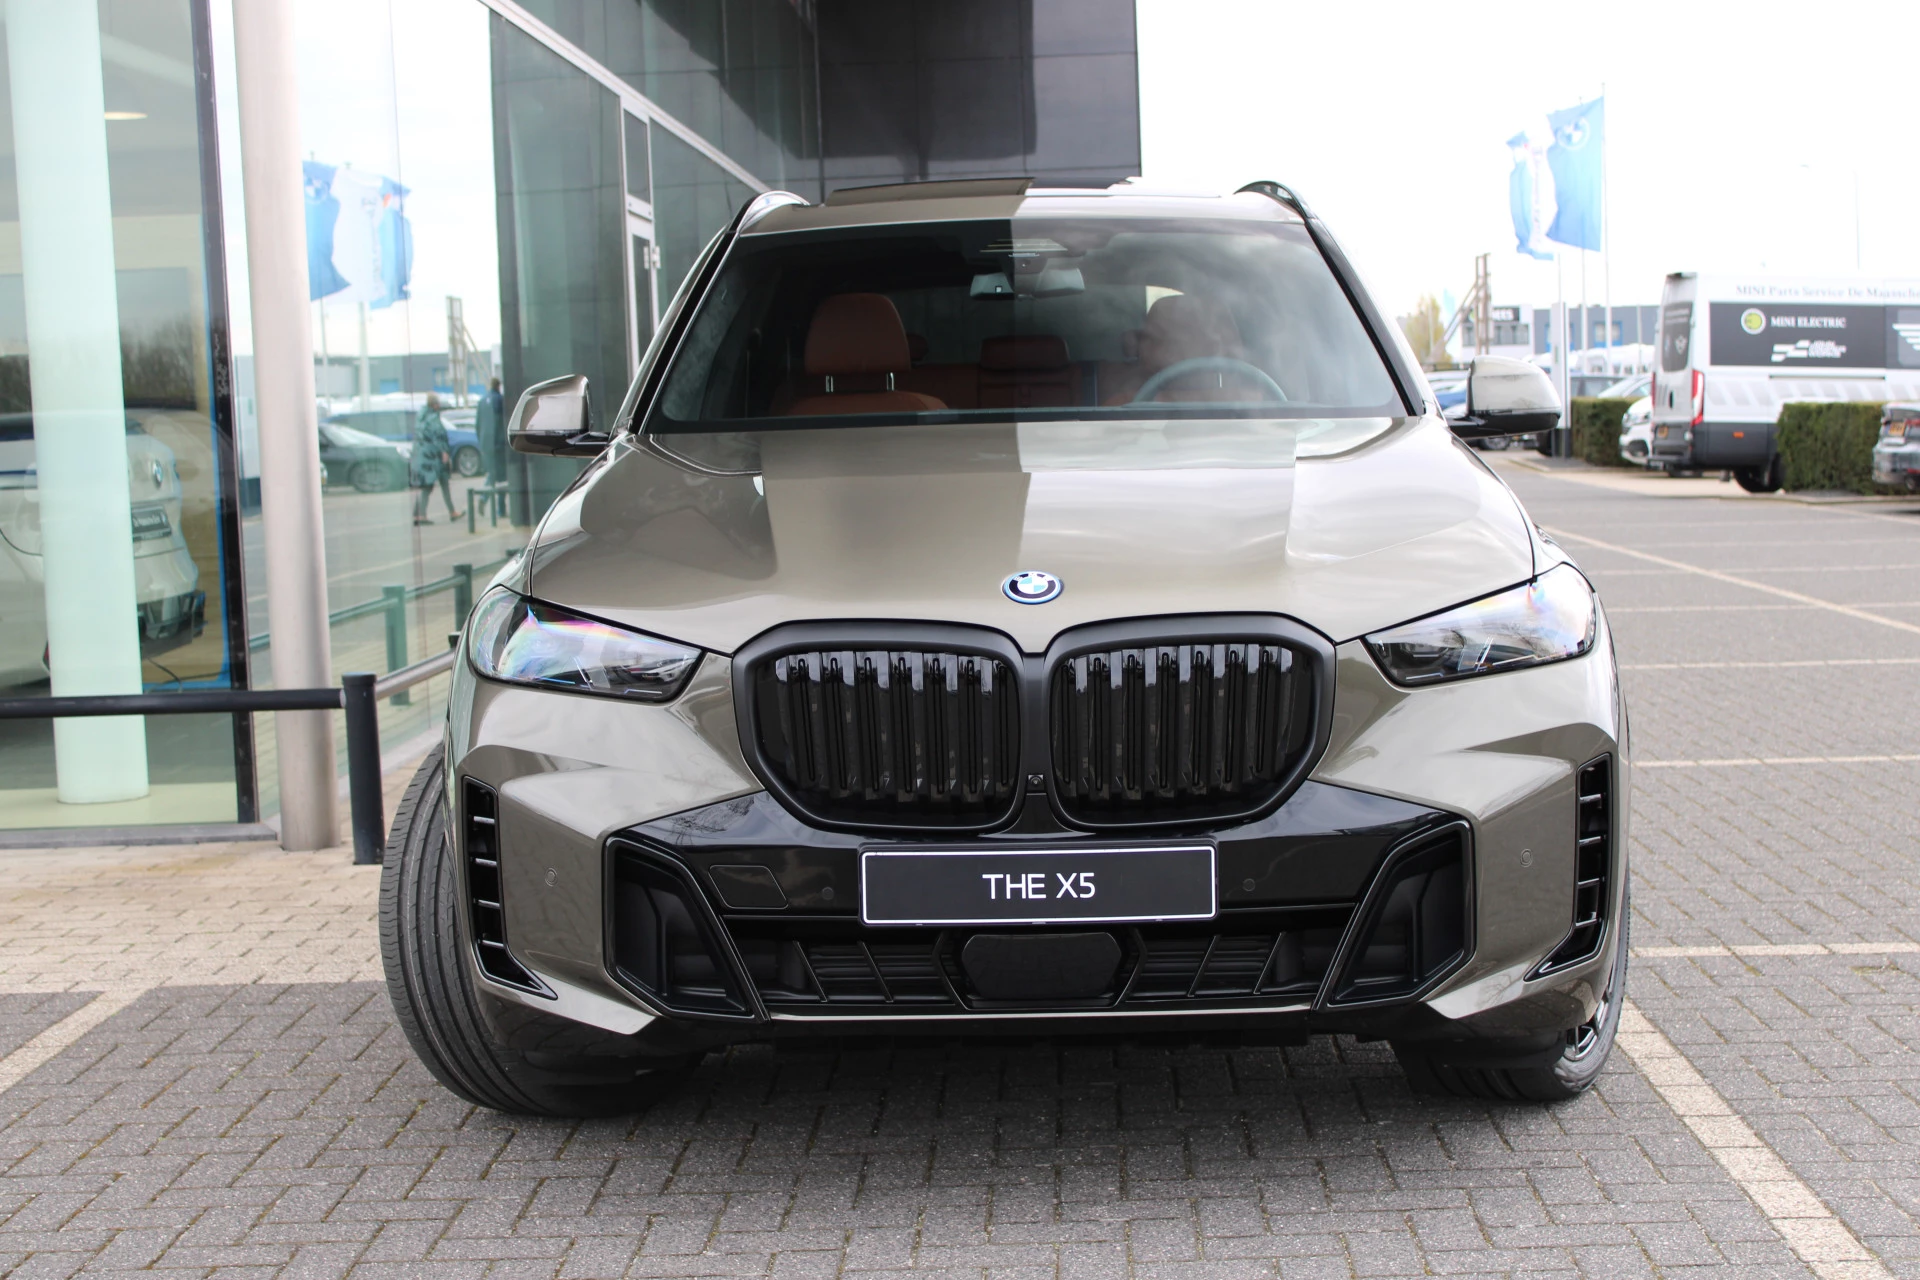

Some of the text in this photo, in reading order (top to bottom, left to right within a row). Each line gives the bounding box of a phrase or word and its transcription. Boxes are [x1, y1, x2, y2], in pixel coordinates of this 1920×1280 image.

[1736, 285, 1766, 297] MINI
[1769, 286, 1799, 297] Parts
[1802, 286, 1845, 298] Service
[1771, 316, 1847, 329] MINI ELECTRIC
[982, 872, 1096, 900] THE X5
